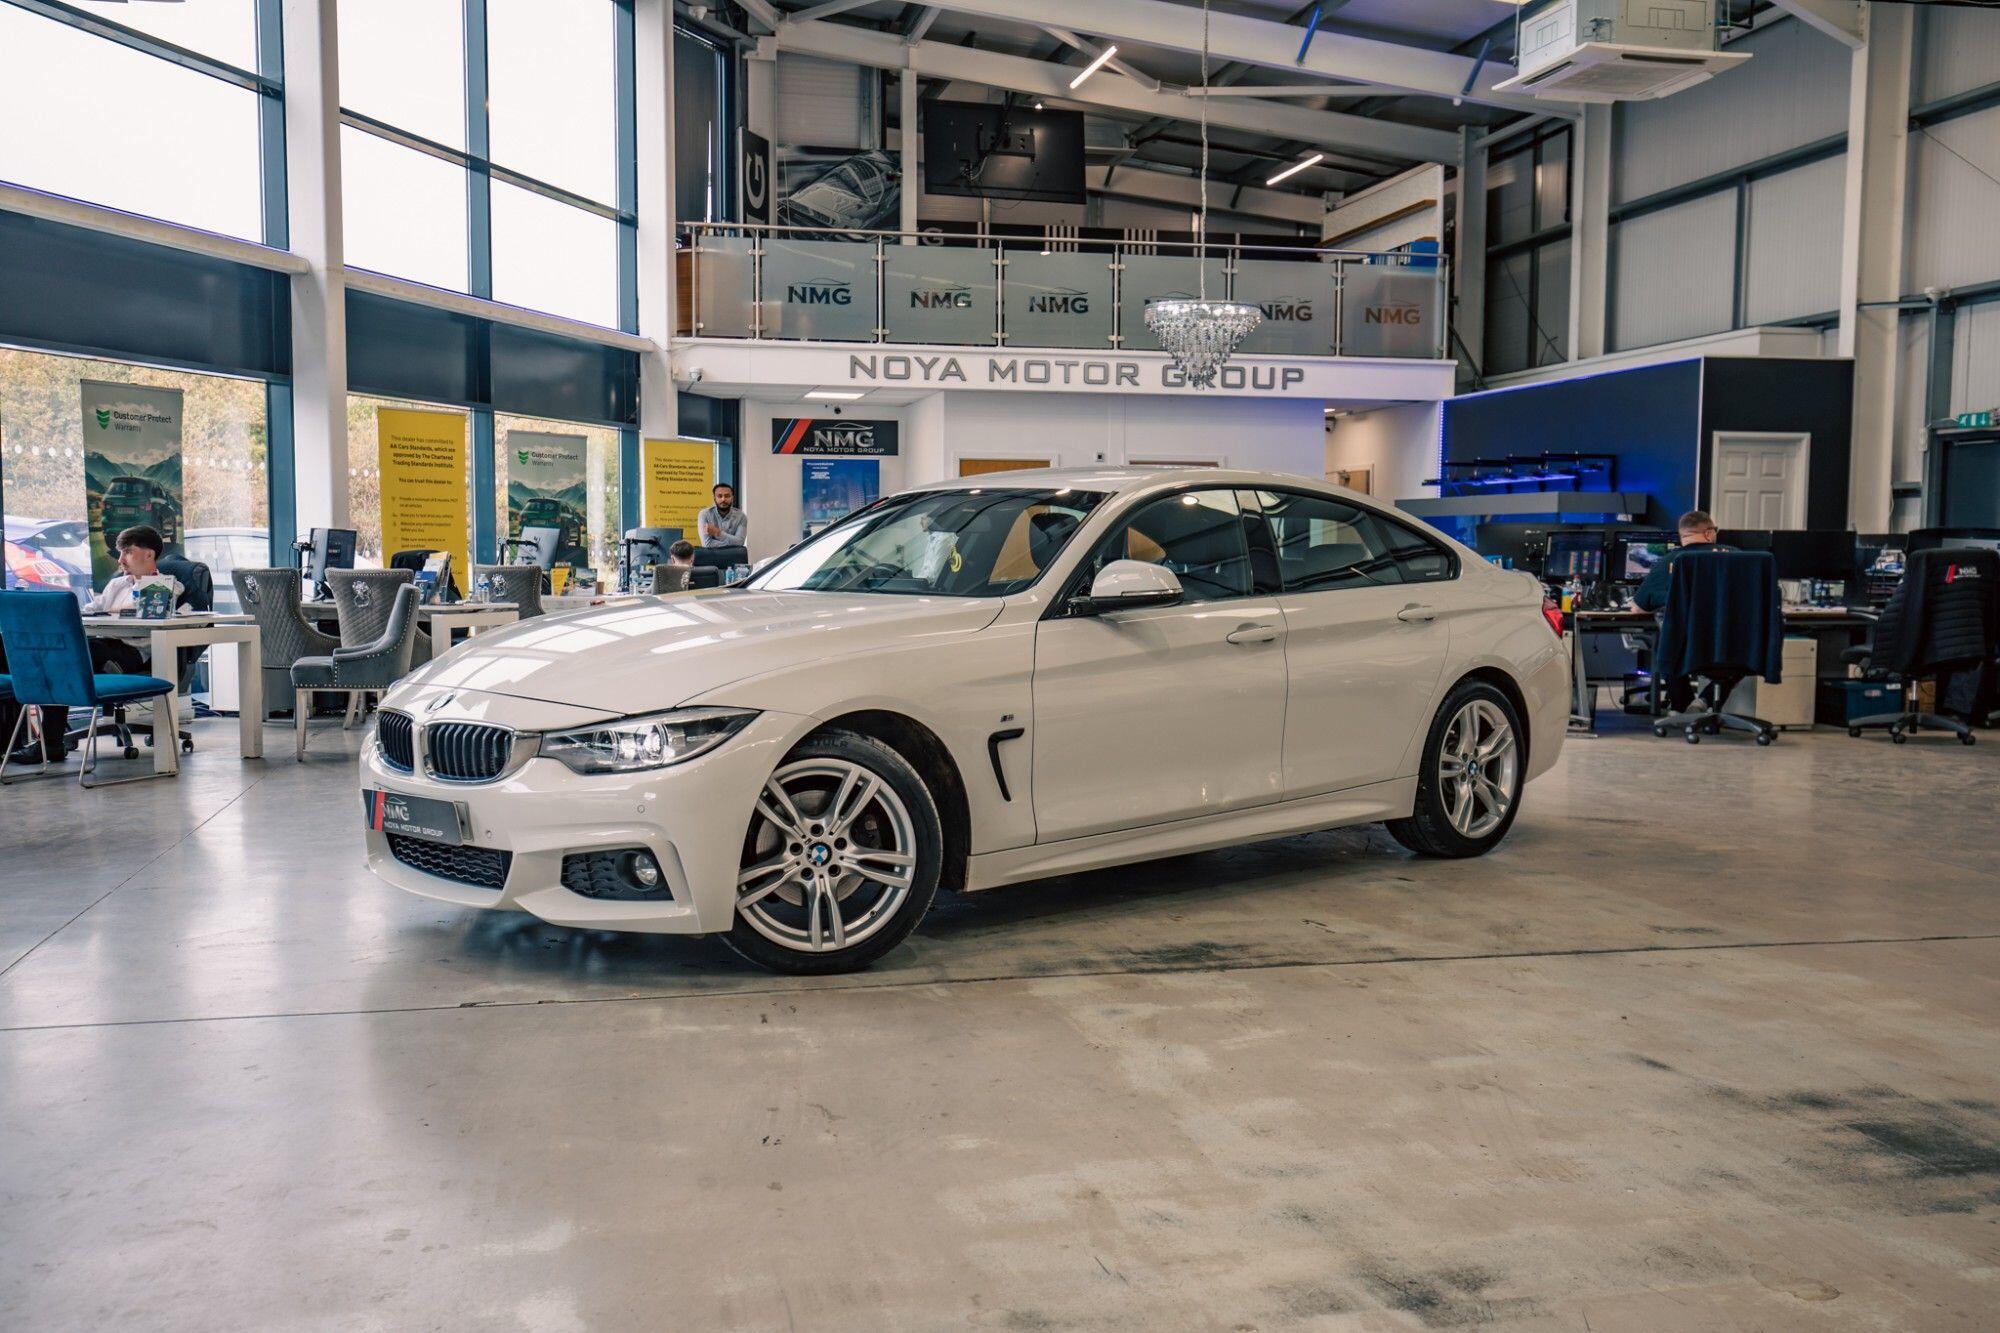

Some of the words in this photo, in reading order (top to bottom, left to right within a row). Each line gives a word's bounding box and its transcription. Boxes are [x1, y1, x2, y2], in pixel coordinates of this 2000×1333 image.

[787, 285, 852, 306] NMG
[910, 291, 972, 309] NMG
[1028, 296, 1089, 314] NMG
[1260, 304, 1313, 321] NMG
[1365, 307, 1421, 325] NMG
[849, 355, 967, 382] NOYA
[988, 358, 1141, 387] MOTOR
[113, 411, 146, 422] Customer
[147, 414, 172, 424] Protect
[813, 429, 874, 448] NMG
[531, 451, 558, 459] Customer
[381, 802, 410, 821] NMG
[384, 821, 399, 830] NOYA
[400, 824, 422, 834] MOTOR
[422, 827, 444, 837] GROUP
